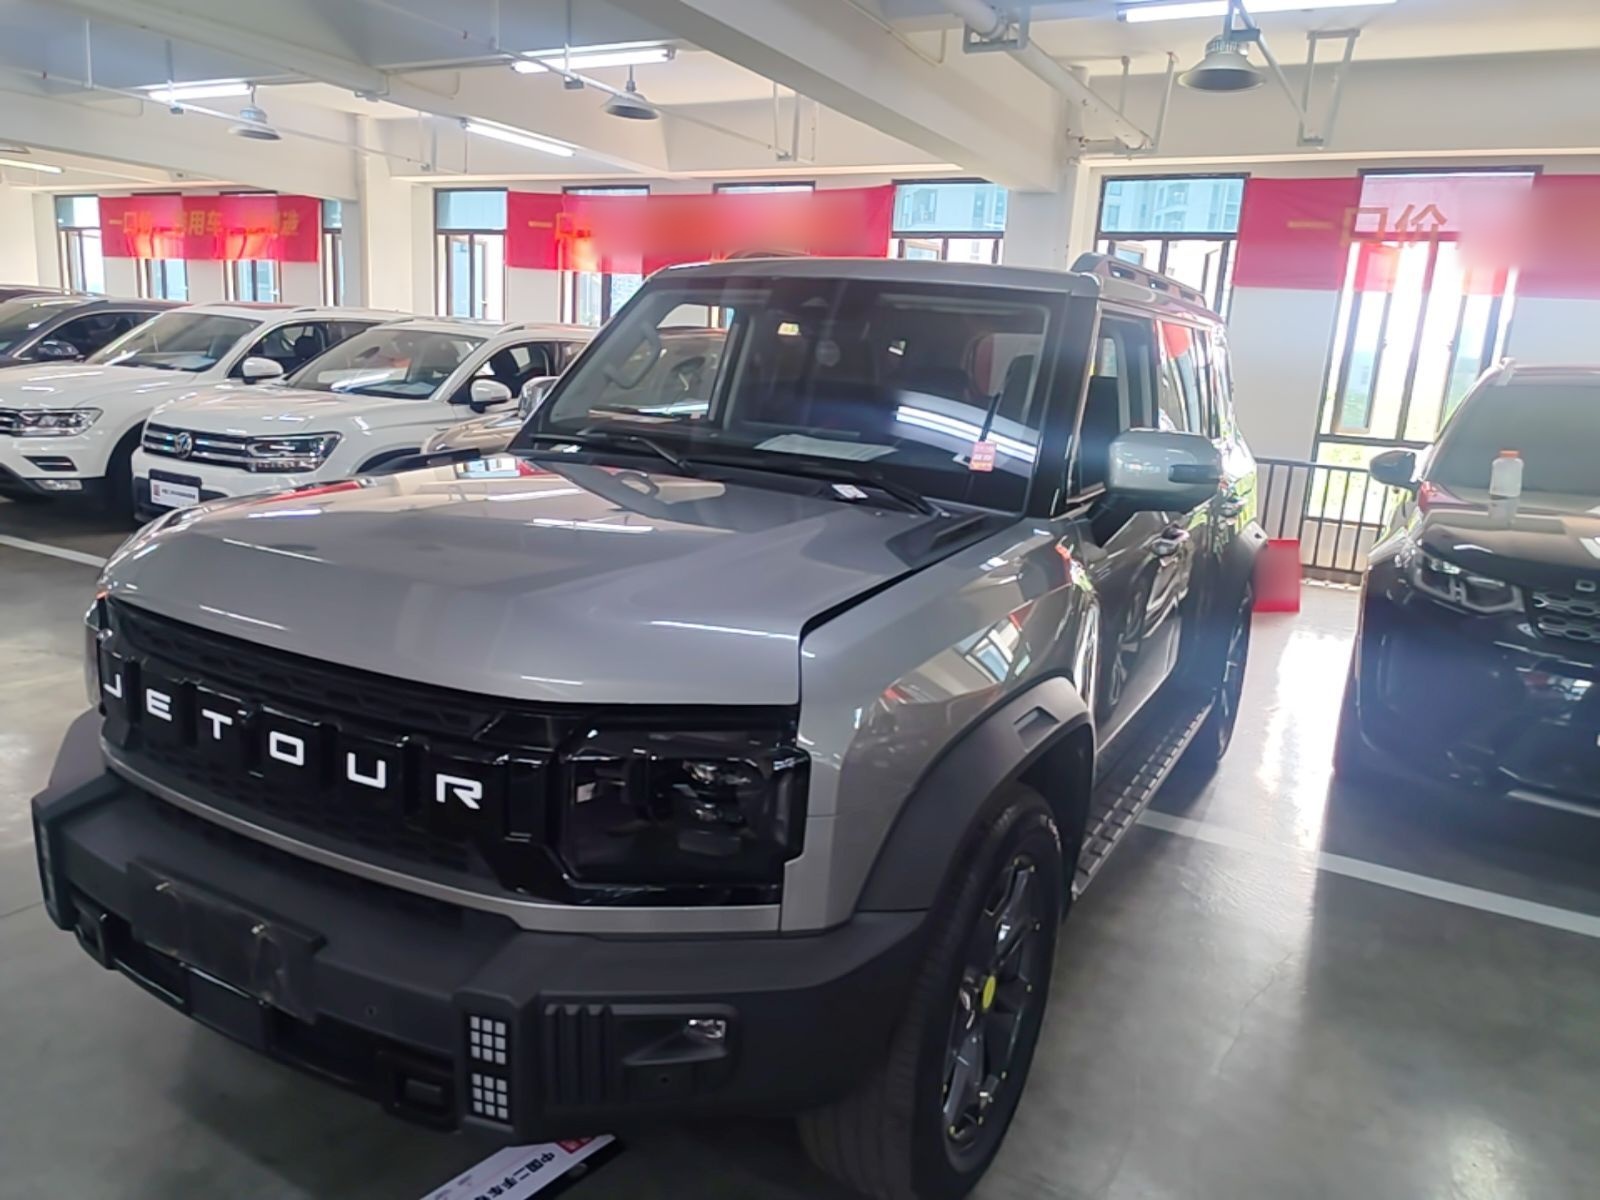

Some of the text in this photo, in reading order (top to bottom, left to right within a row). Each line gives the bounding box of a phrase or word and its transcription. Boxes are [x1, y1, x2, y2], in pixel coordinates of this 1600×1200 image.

[1286, 203, 1448, 249] 一口价
[103, 673, 483, 809] JETOUR
